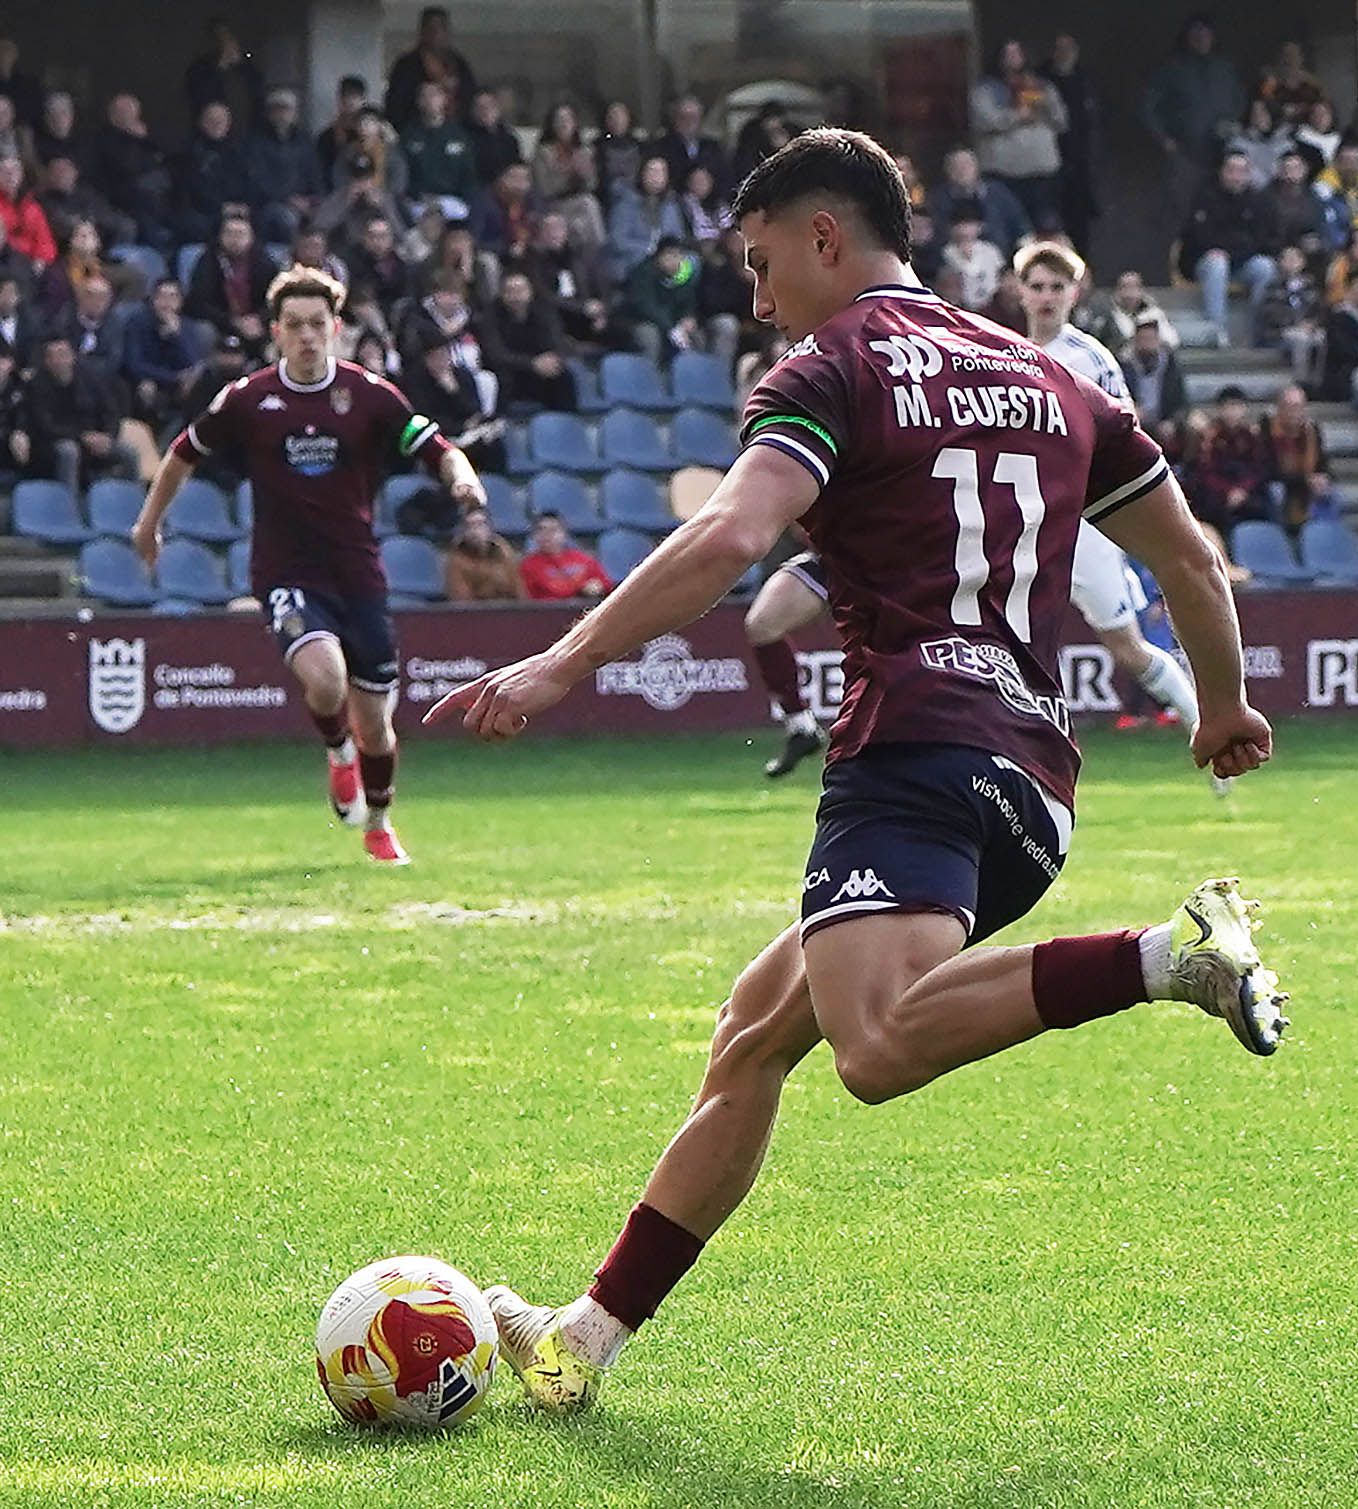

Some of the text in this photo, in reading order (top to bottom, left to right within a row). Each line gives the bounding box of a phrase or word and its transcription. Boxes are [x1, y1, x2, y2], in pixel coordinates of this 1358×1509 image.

[951, 355, 1045, 379] Pontevedra
[894, 384, 1069, 437] M. CUESTA
[931, 447, 1047, 643] 11
